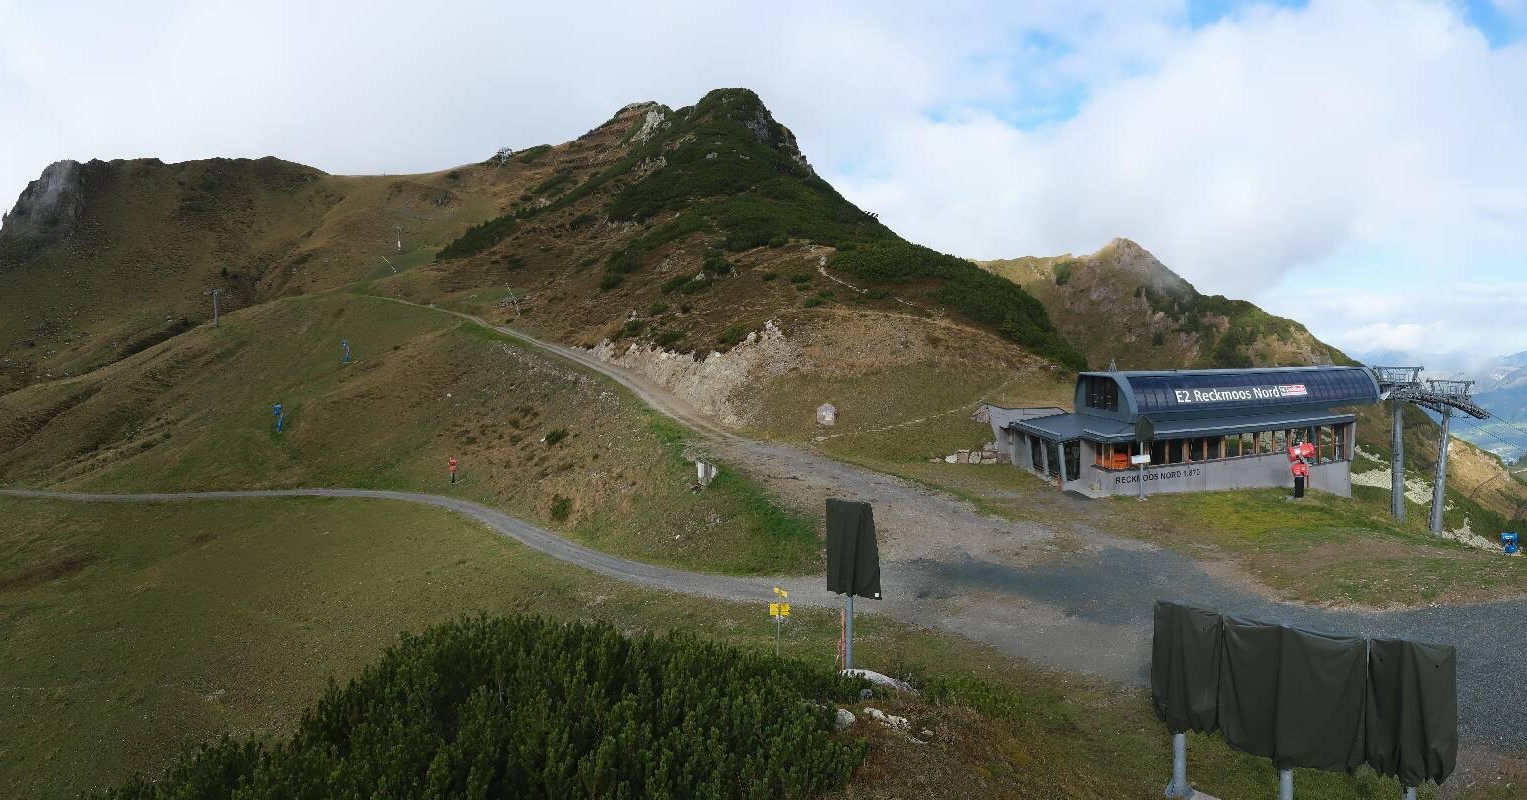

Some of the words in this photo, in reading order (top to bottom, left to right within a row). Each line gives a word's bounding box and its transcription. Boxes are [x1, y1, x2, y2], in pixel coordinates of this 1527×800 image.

[1175, 390, 1191, 403] E2
[1194, 389, 1252, 402] Reckmoos
[1253, 386, 1280, 399] Nord
[1160, 470, 1182, 480] NORD
